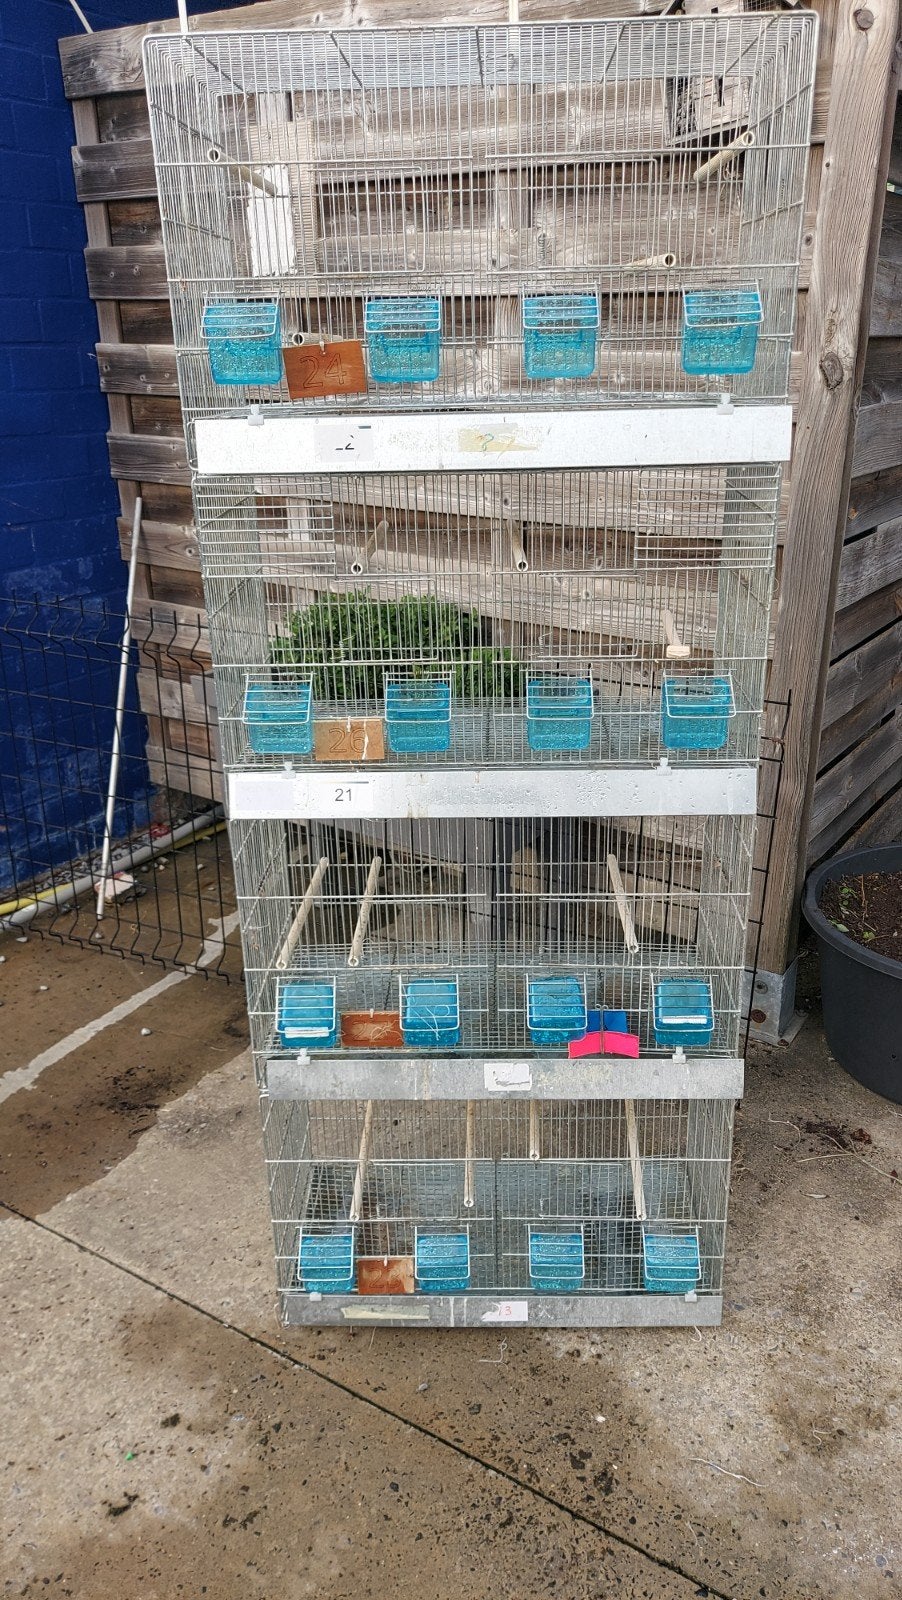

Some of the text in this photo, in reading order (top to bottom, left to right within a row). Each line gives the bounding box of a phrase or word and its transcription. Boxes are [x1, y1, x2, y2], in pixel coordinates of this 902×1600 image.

[300, 353, 347, 389] 24
[328, 727, 367, 754] 26
[334, 788, 352, 802] 21
